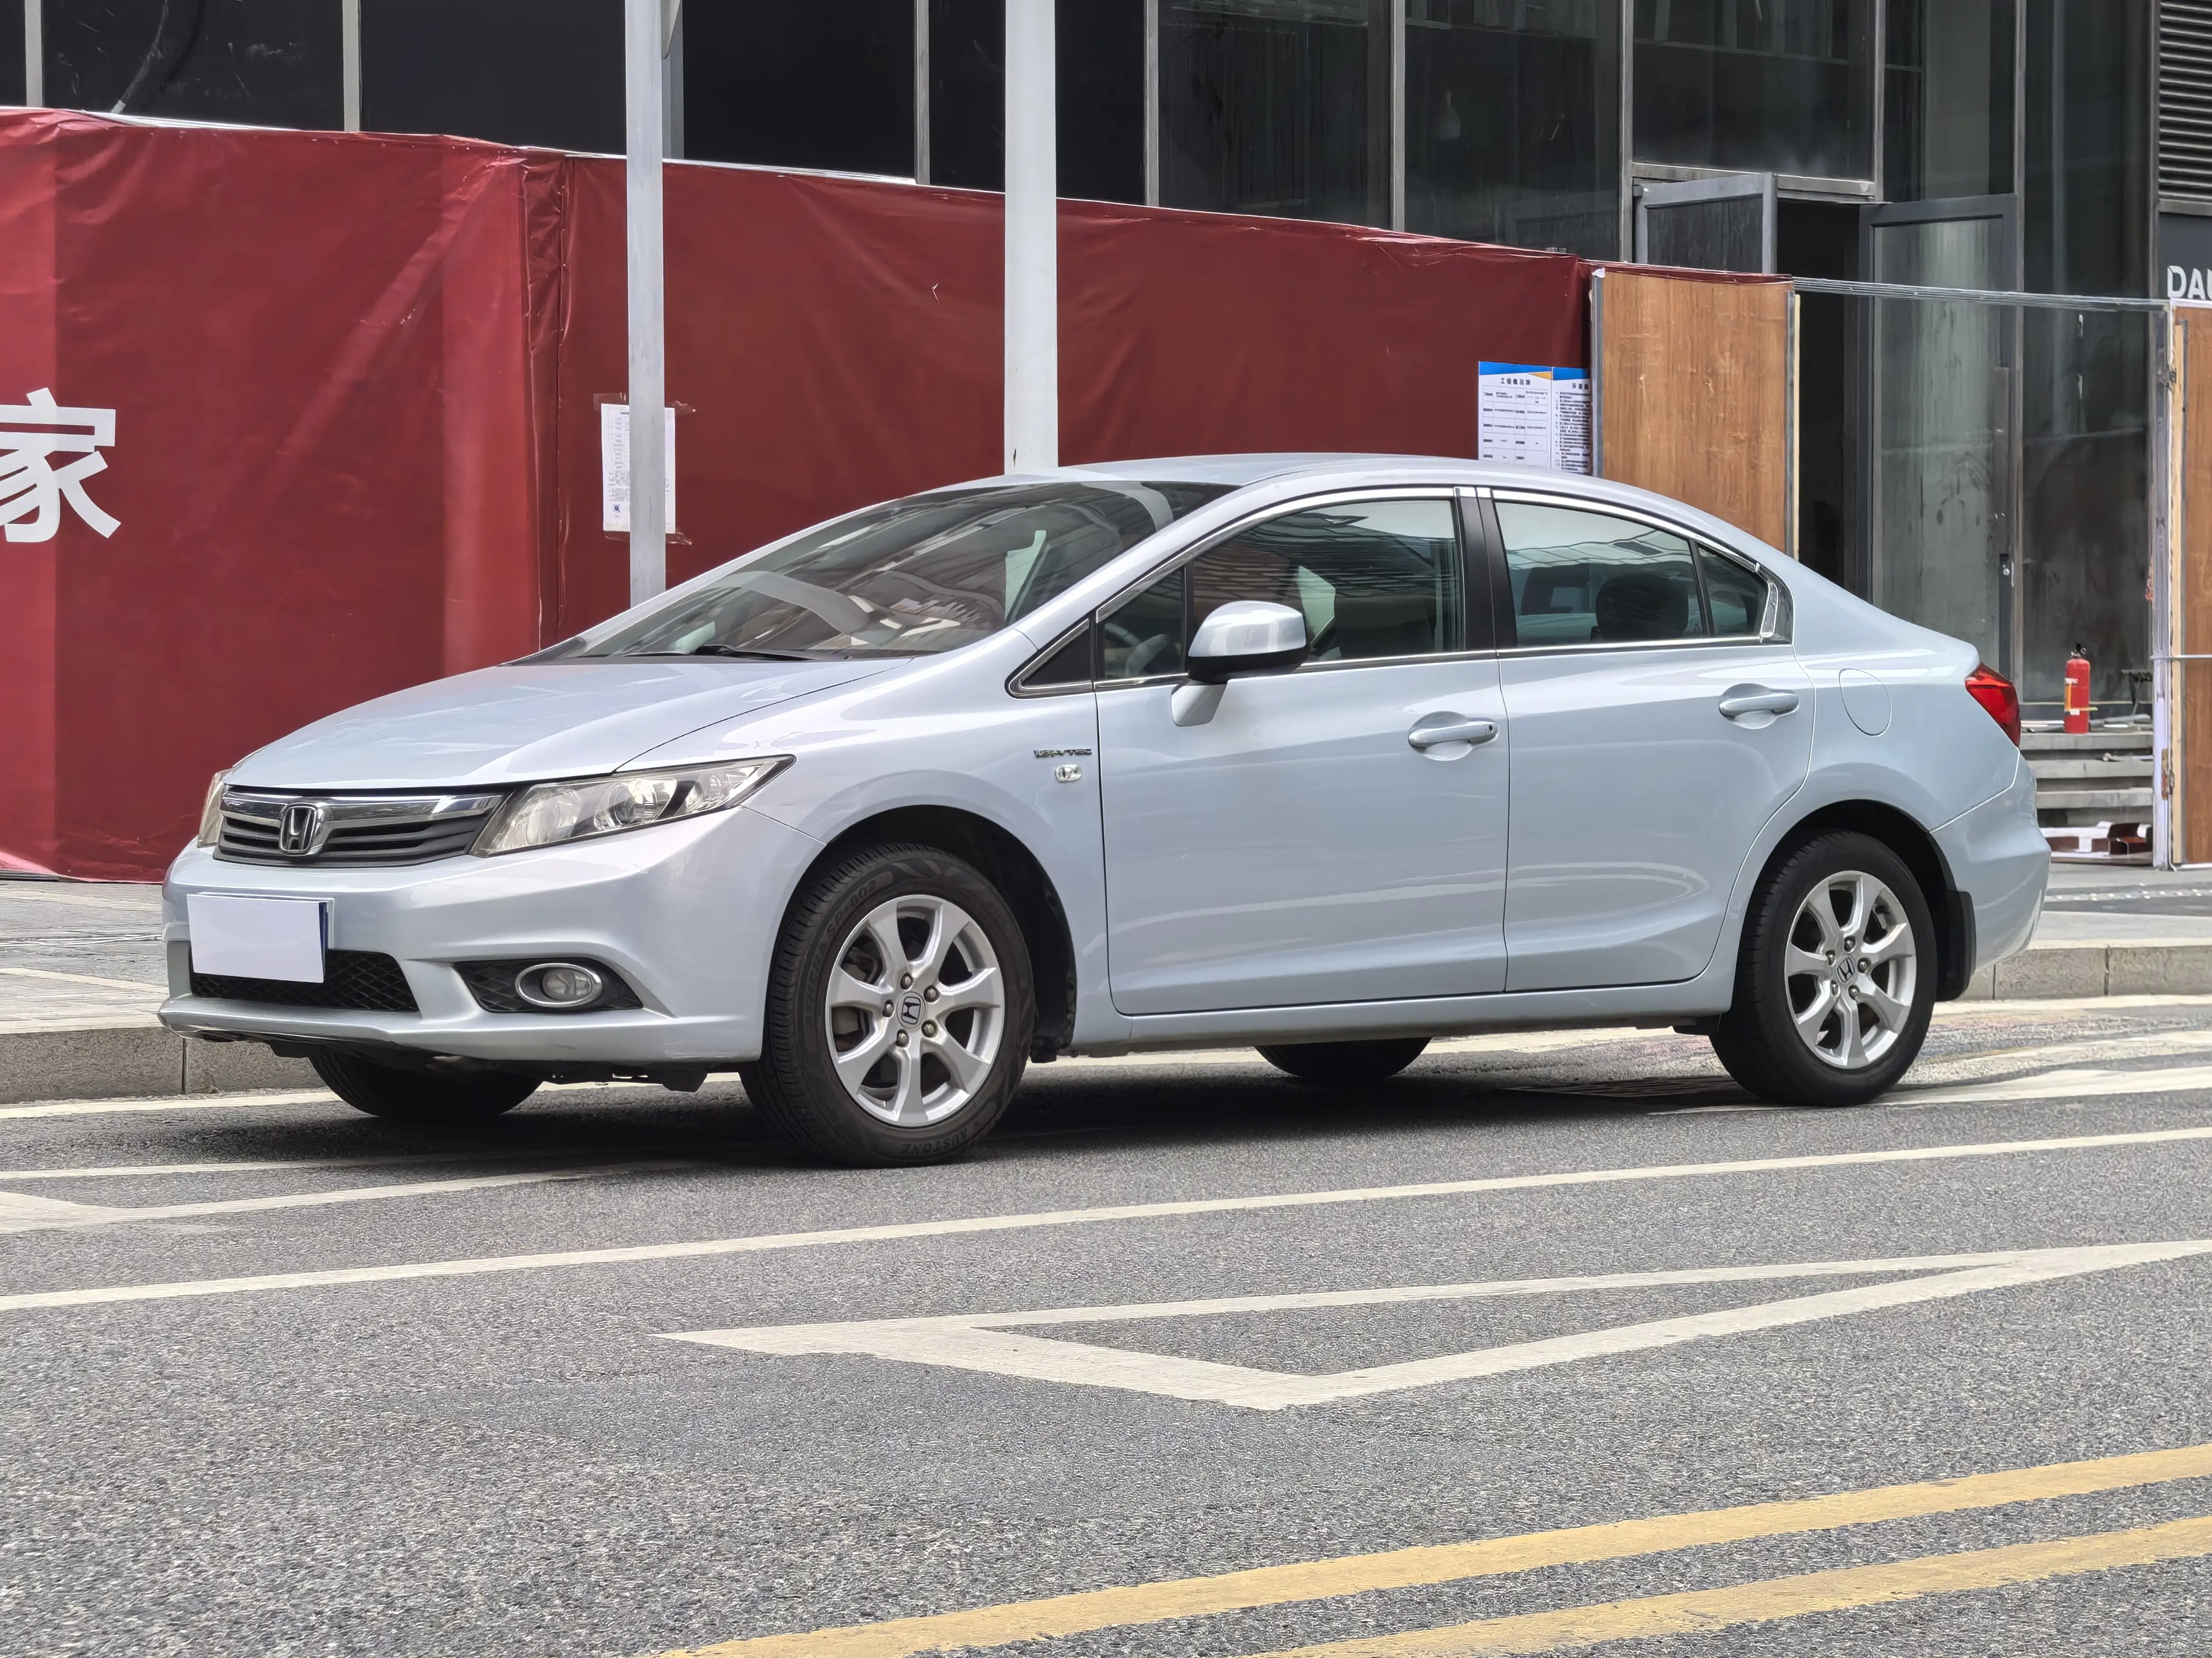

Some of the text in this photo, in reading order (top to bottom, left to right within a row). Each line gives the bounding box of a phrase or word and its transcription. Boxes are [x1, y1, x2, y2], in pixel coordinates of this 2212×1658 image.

[2167, 266, 2212, 300] DA
[0, 387, 121, 543] 家
[900, 1127, 968, 1155] AUSTONE
